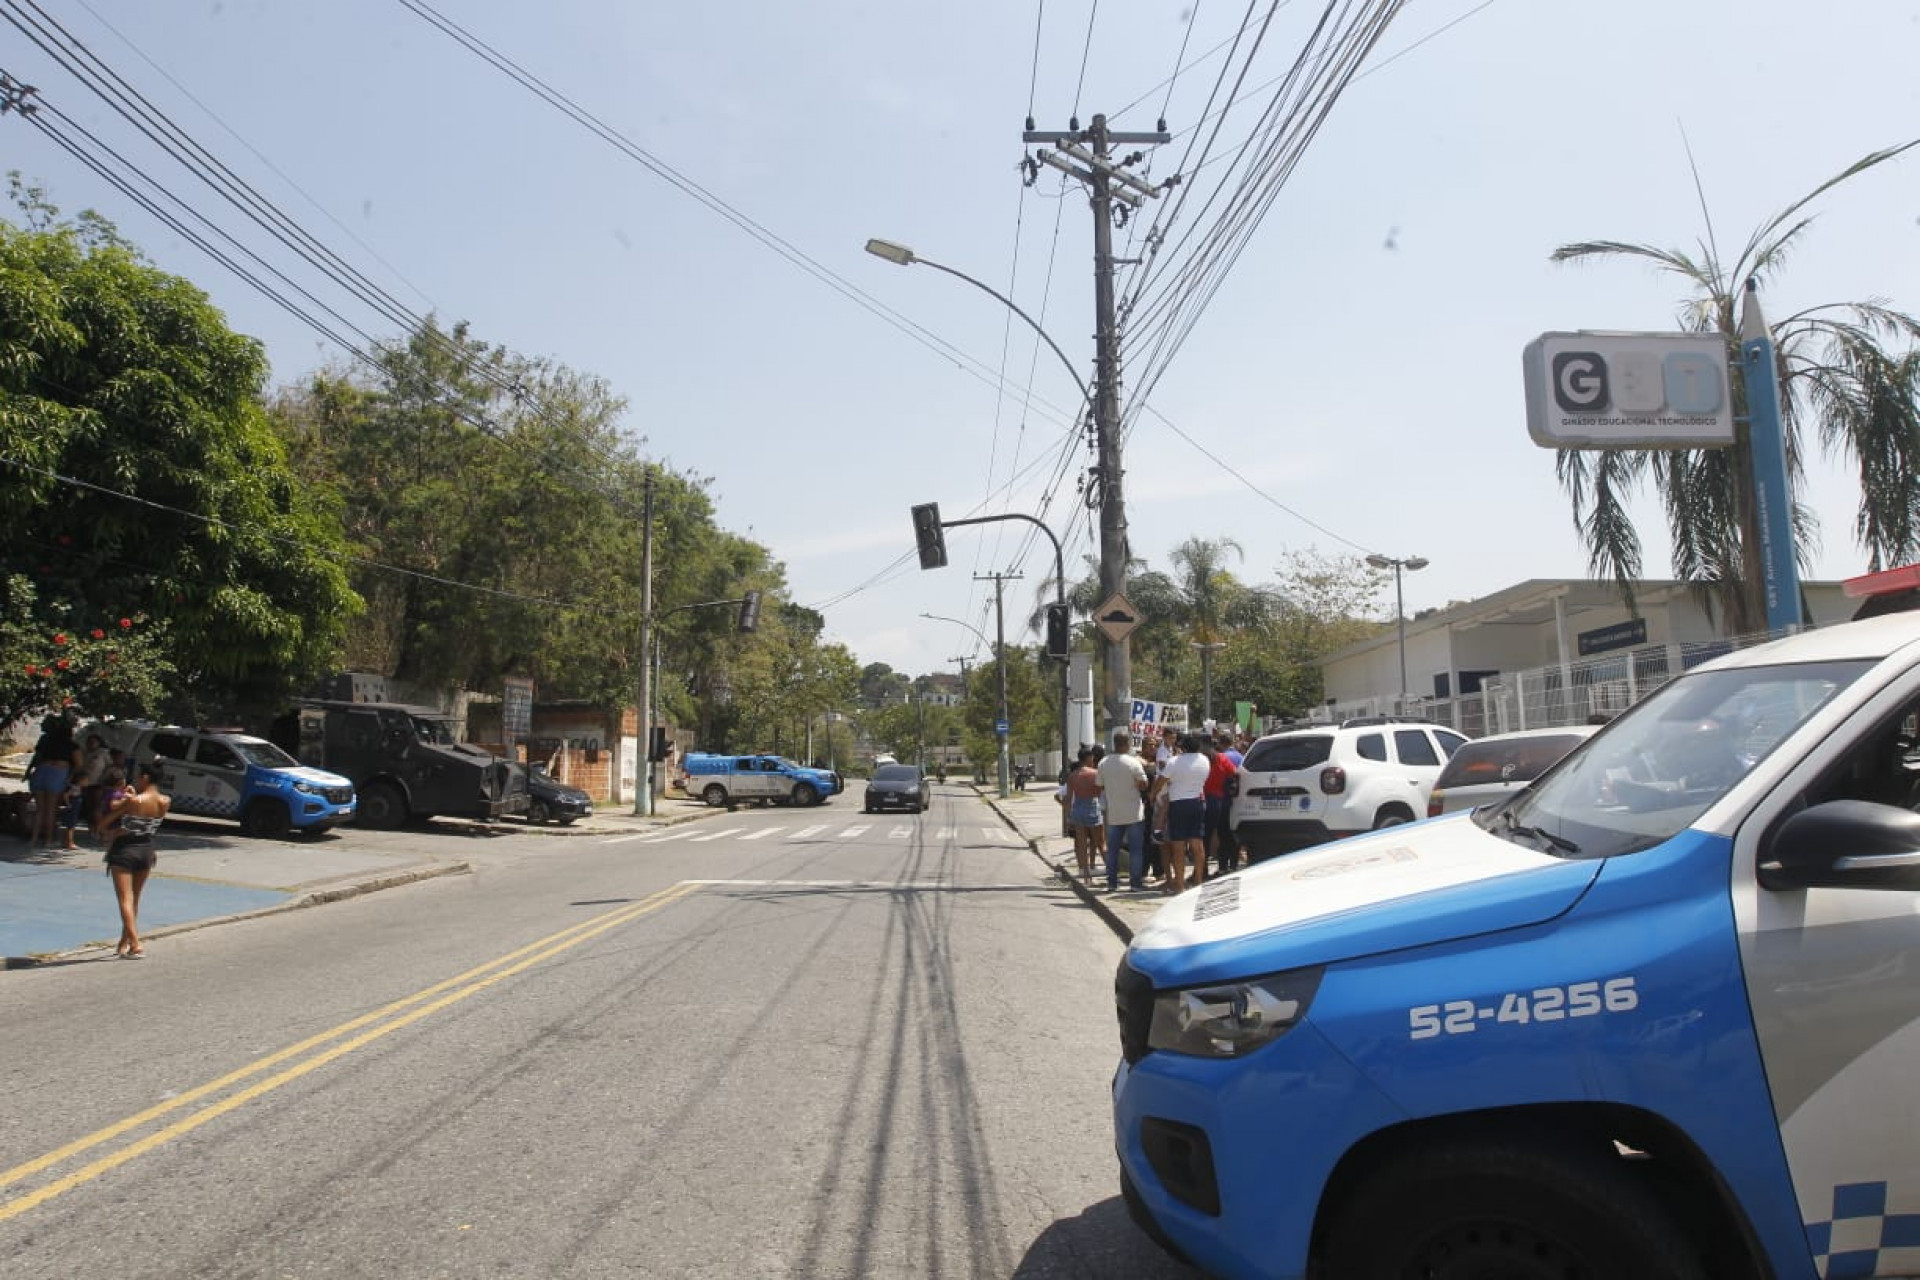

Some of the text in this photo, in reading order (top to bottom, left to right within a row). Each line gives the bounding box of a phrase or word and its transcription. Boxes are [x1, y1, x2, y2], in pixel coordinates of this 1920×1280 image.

[1562, 416, 1717, 426] GINÁSIO EDUCACIONAL TECNOLÓGICO
[1409, 977, 1639, 1040] 52-4256
